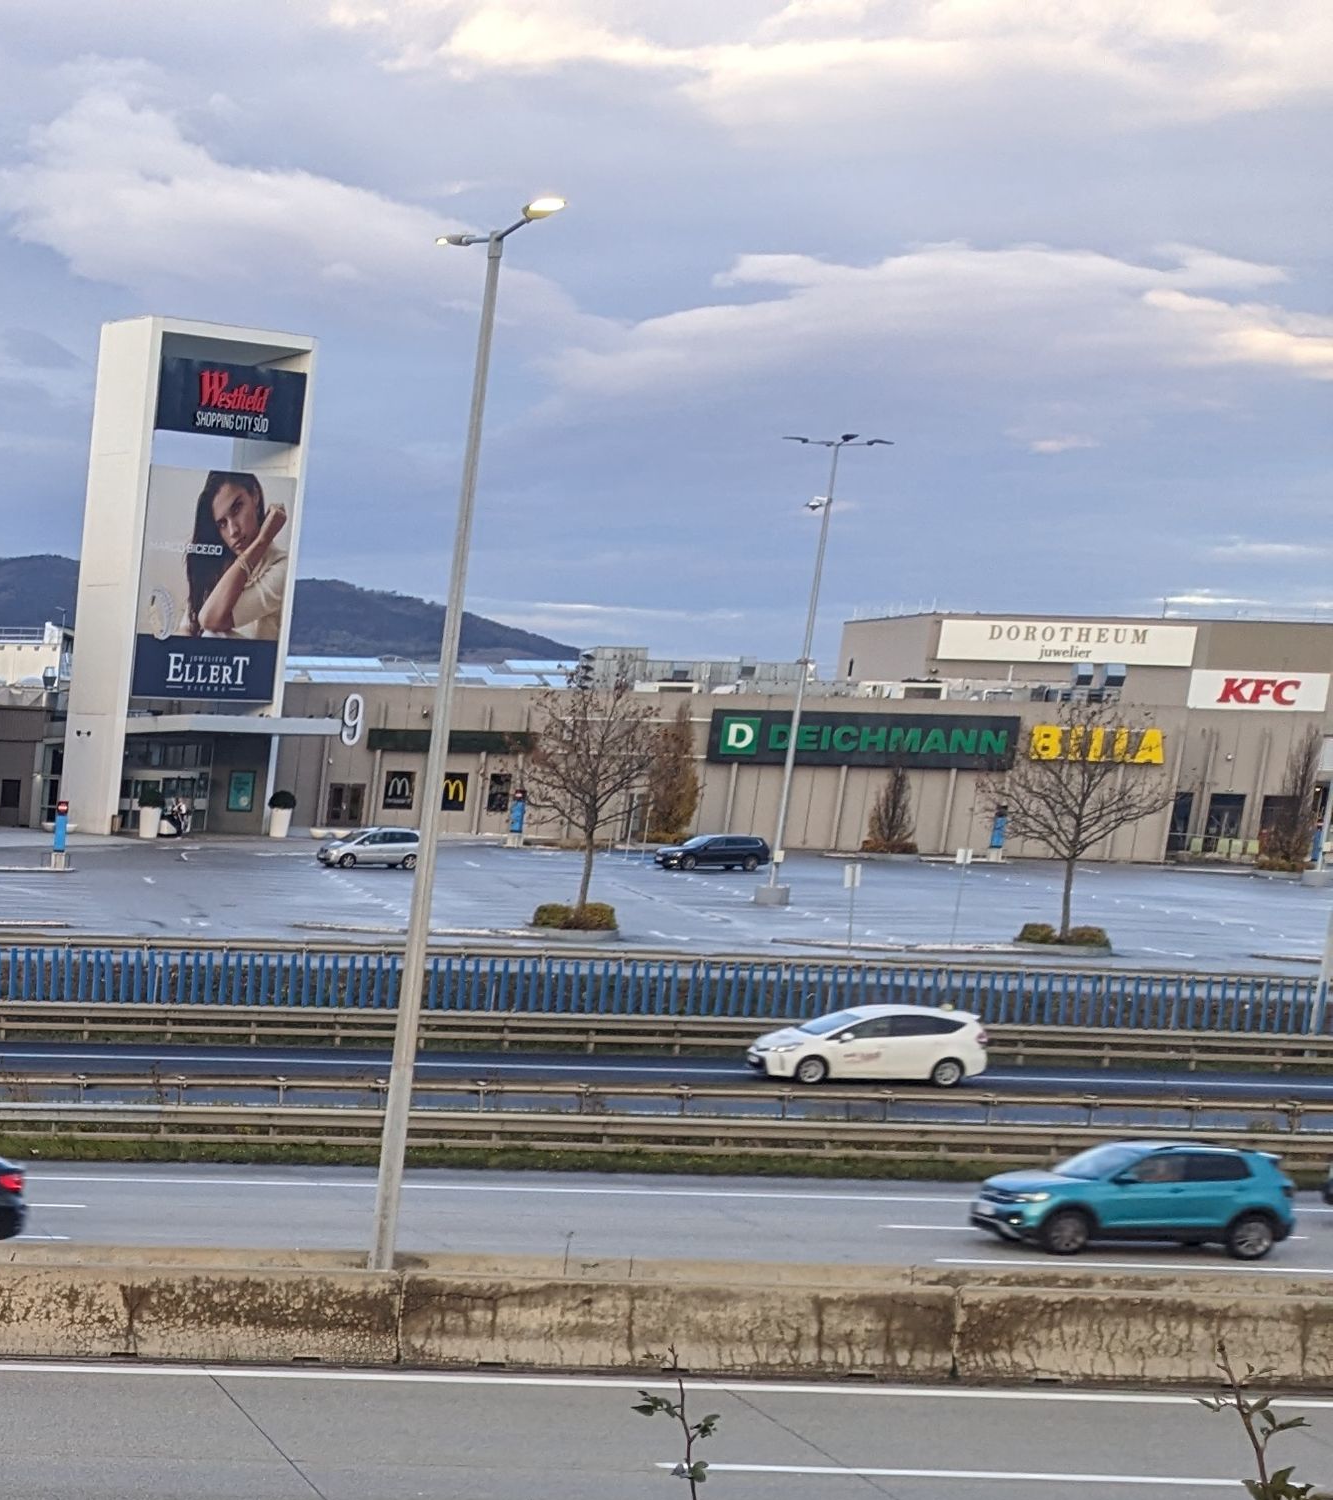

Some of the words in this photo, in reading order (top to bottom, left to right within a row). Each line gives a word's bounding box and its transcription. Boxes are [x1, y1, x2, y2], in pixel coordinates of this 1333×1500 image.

[199, 369, 273, 414] Westfield
[195, 411, 235, 430] SHOPPING
[235, 415, 254, 431] CITY
[252, 414, 269, 433] SÜD
[988, 624, 1149, 645] DOROTHEUM
[1038, 645, 1093, 660] juwelier
[165, 653, 250, 685] ELLERT
[1216, 678, 1302, 706] KFC
[341, 693, 364, 746] 9
[727, 723, 754, 748] D
[767, 723, 1008, 755] DEICHMANN
